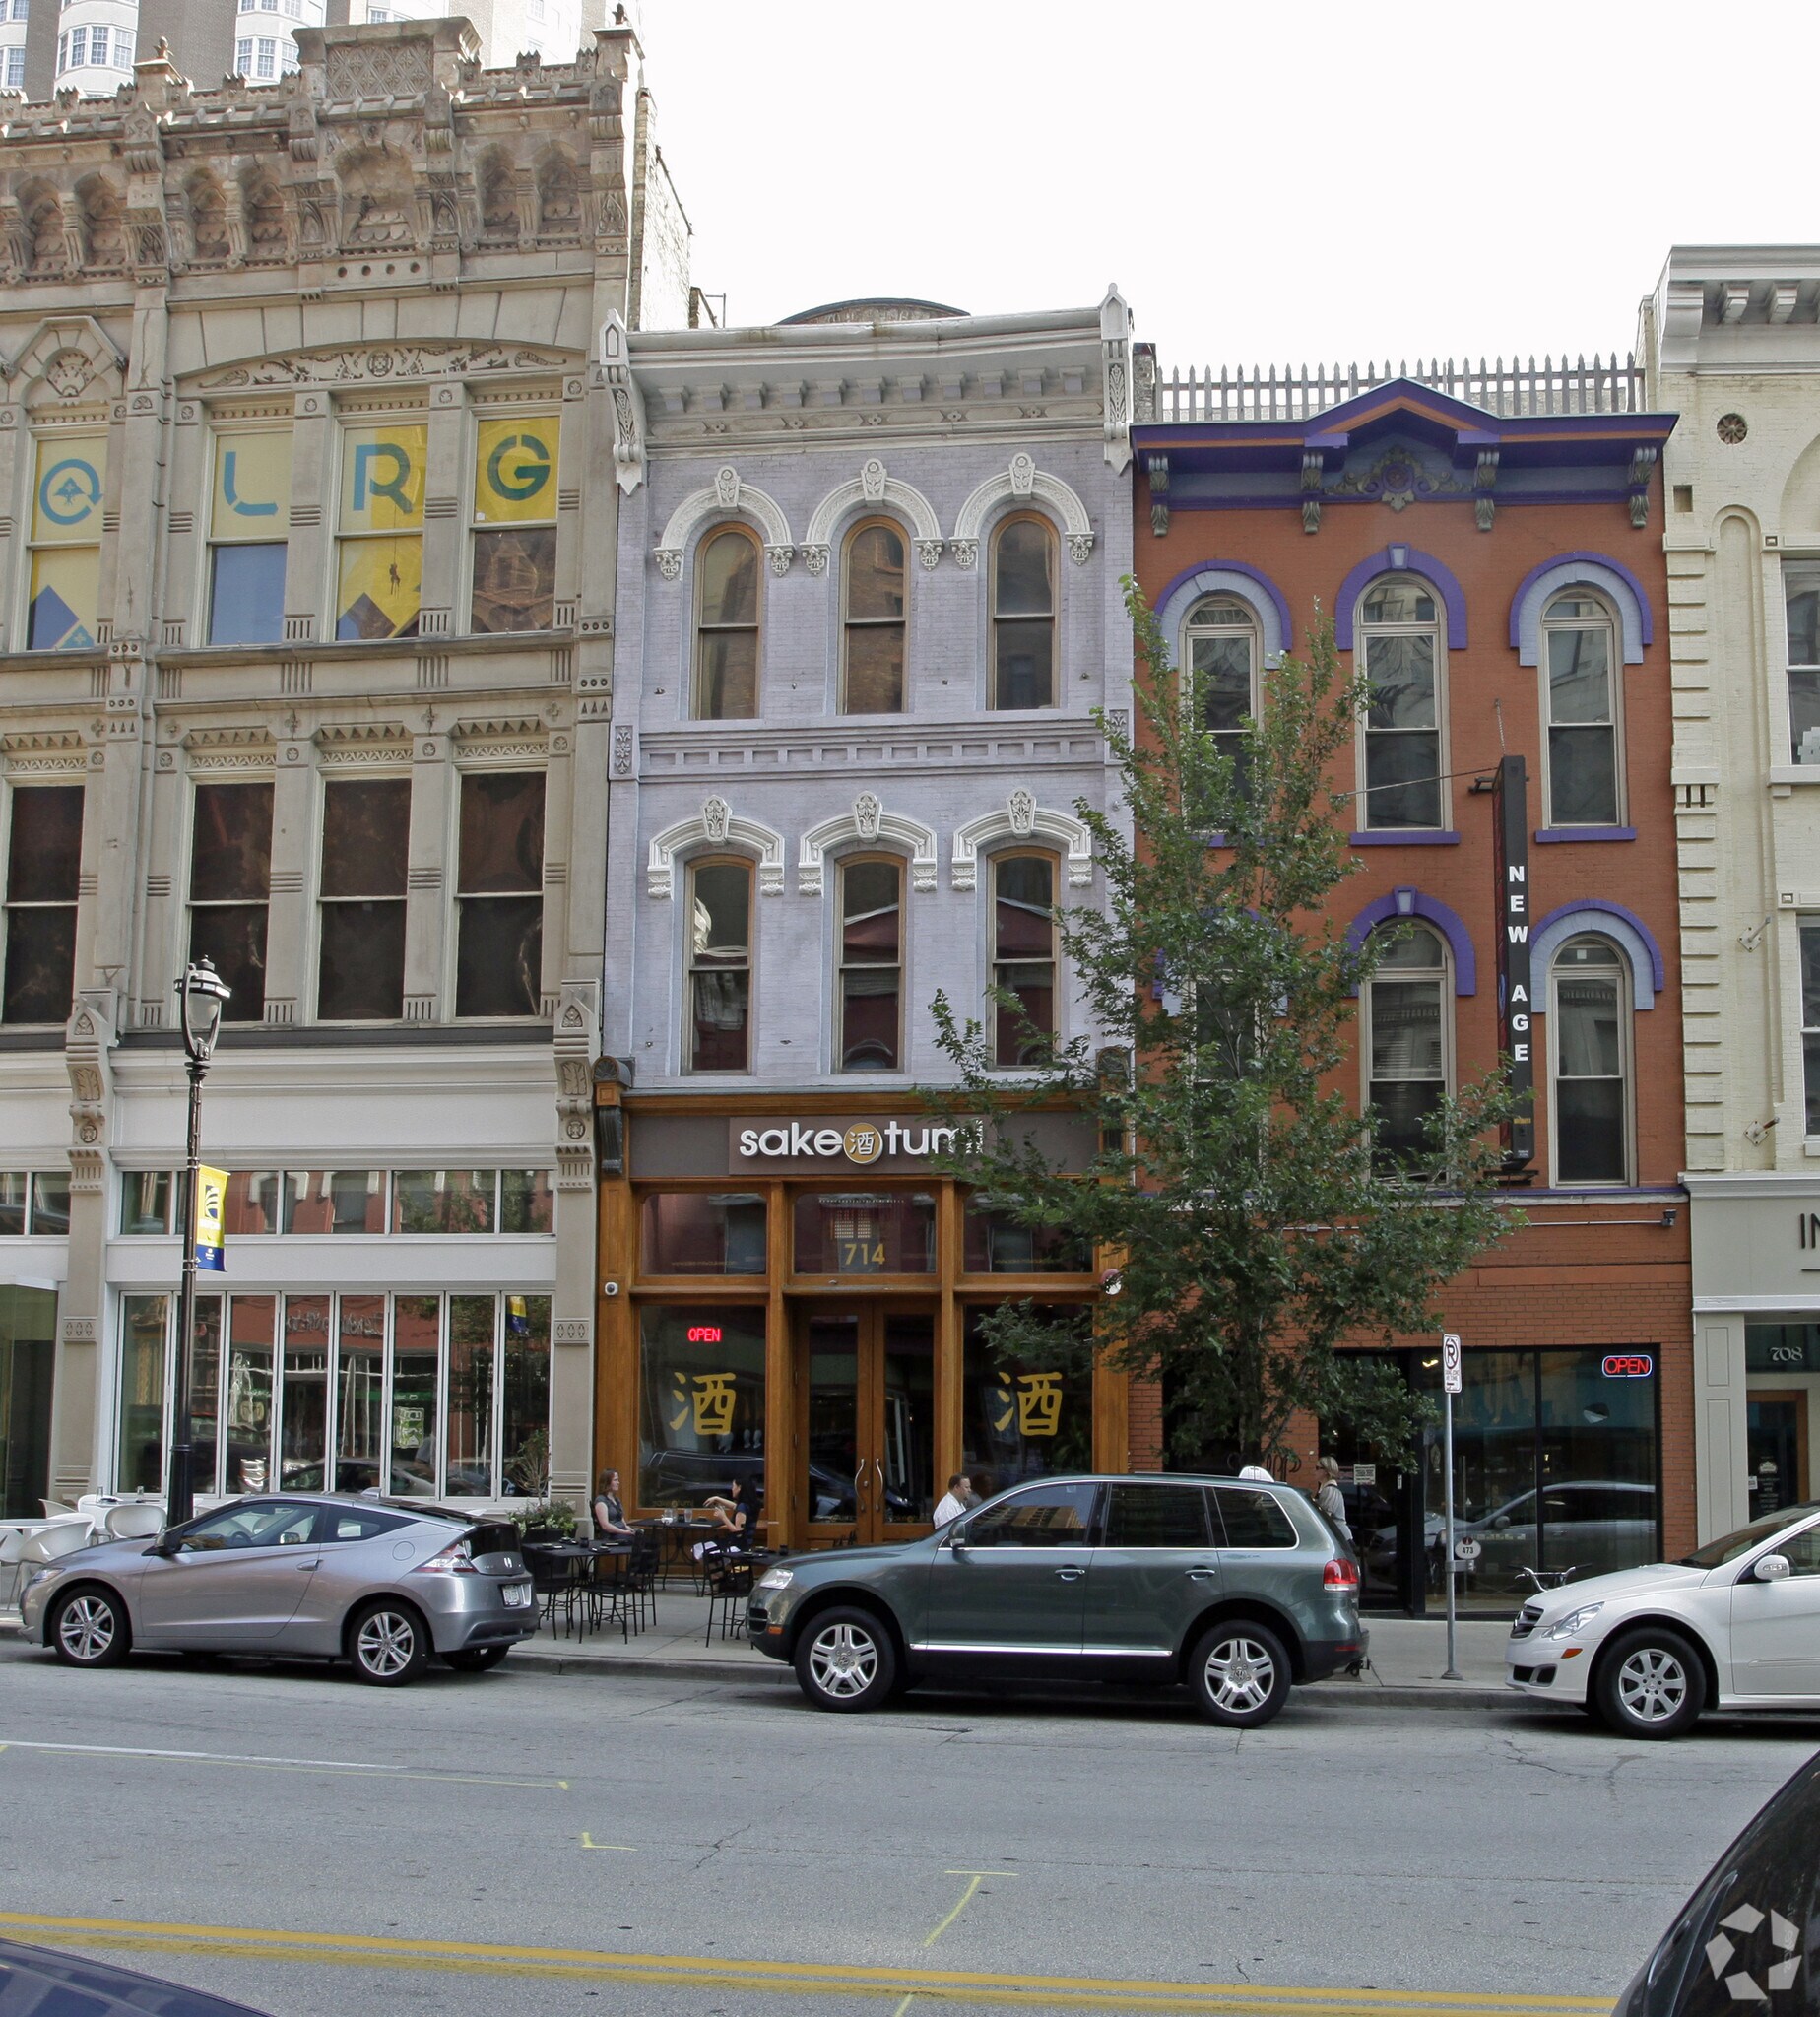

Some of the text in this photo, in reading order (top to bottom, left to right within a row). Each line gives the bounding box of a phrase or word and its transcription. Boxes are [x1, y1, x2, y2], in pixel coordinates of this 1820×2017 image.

[1508, 866, 1529, 1062] NEW AGE
[740, 1122, 843, 1156] sake
[849, 1131, 875, 1155] 酒
[844, 1244, 885, 1265] 714
[688, 1327, 721, 1341] OPEN
[1605, 1358, 1649, 1374] OPEN
[1770, 1346, 1803, 1361] 708
[670, 1372, 737, 1436] 酒
[993, 1371, 1063, 1436] 酒
